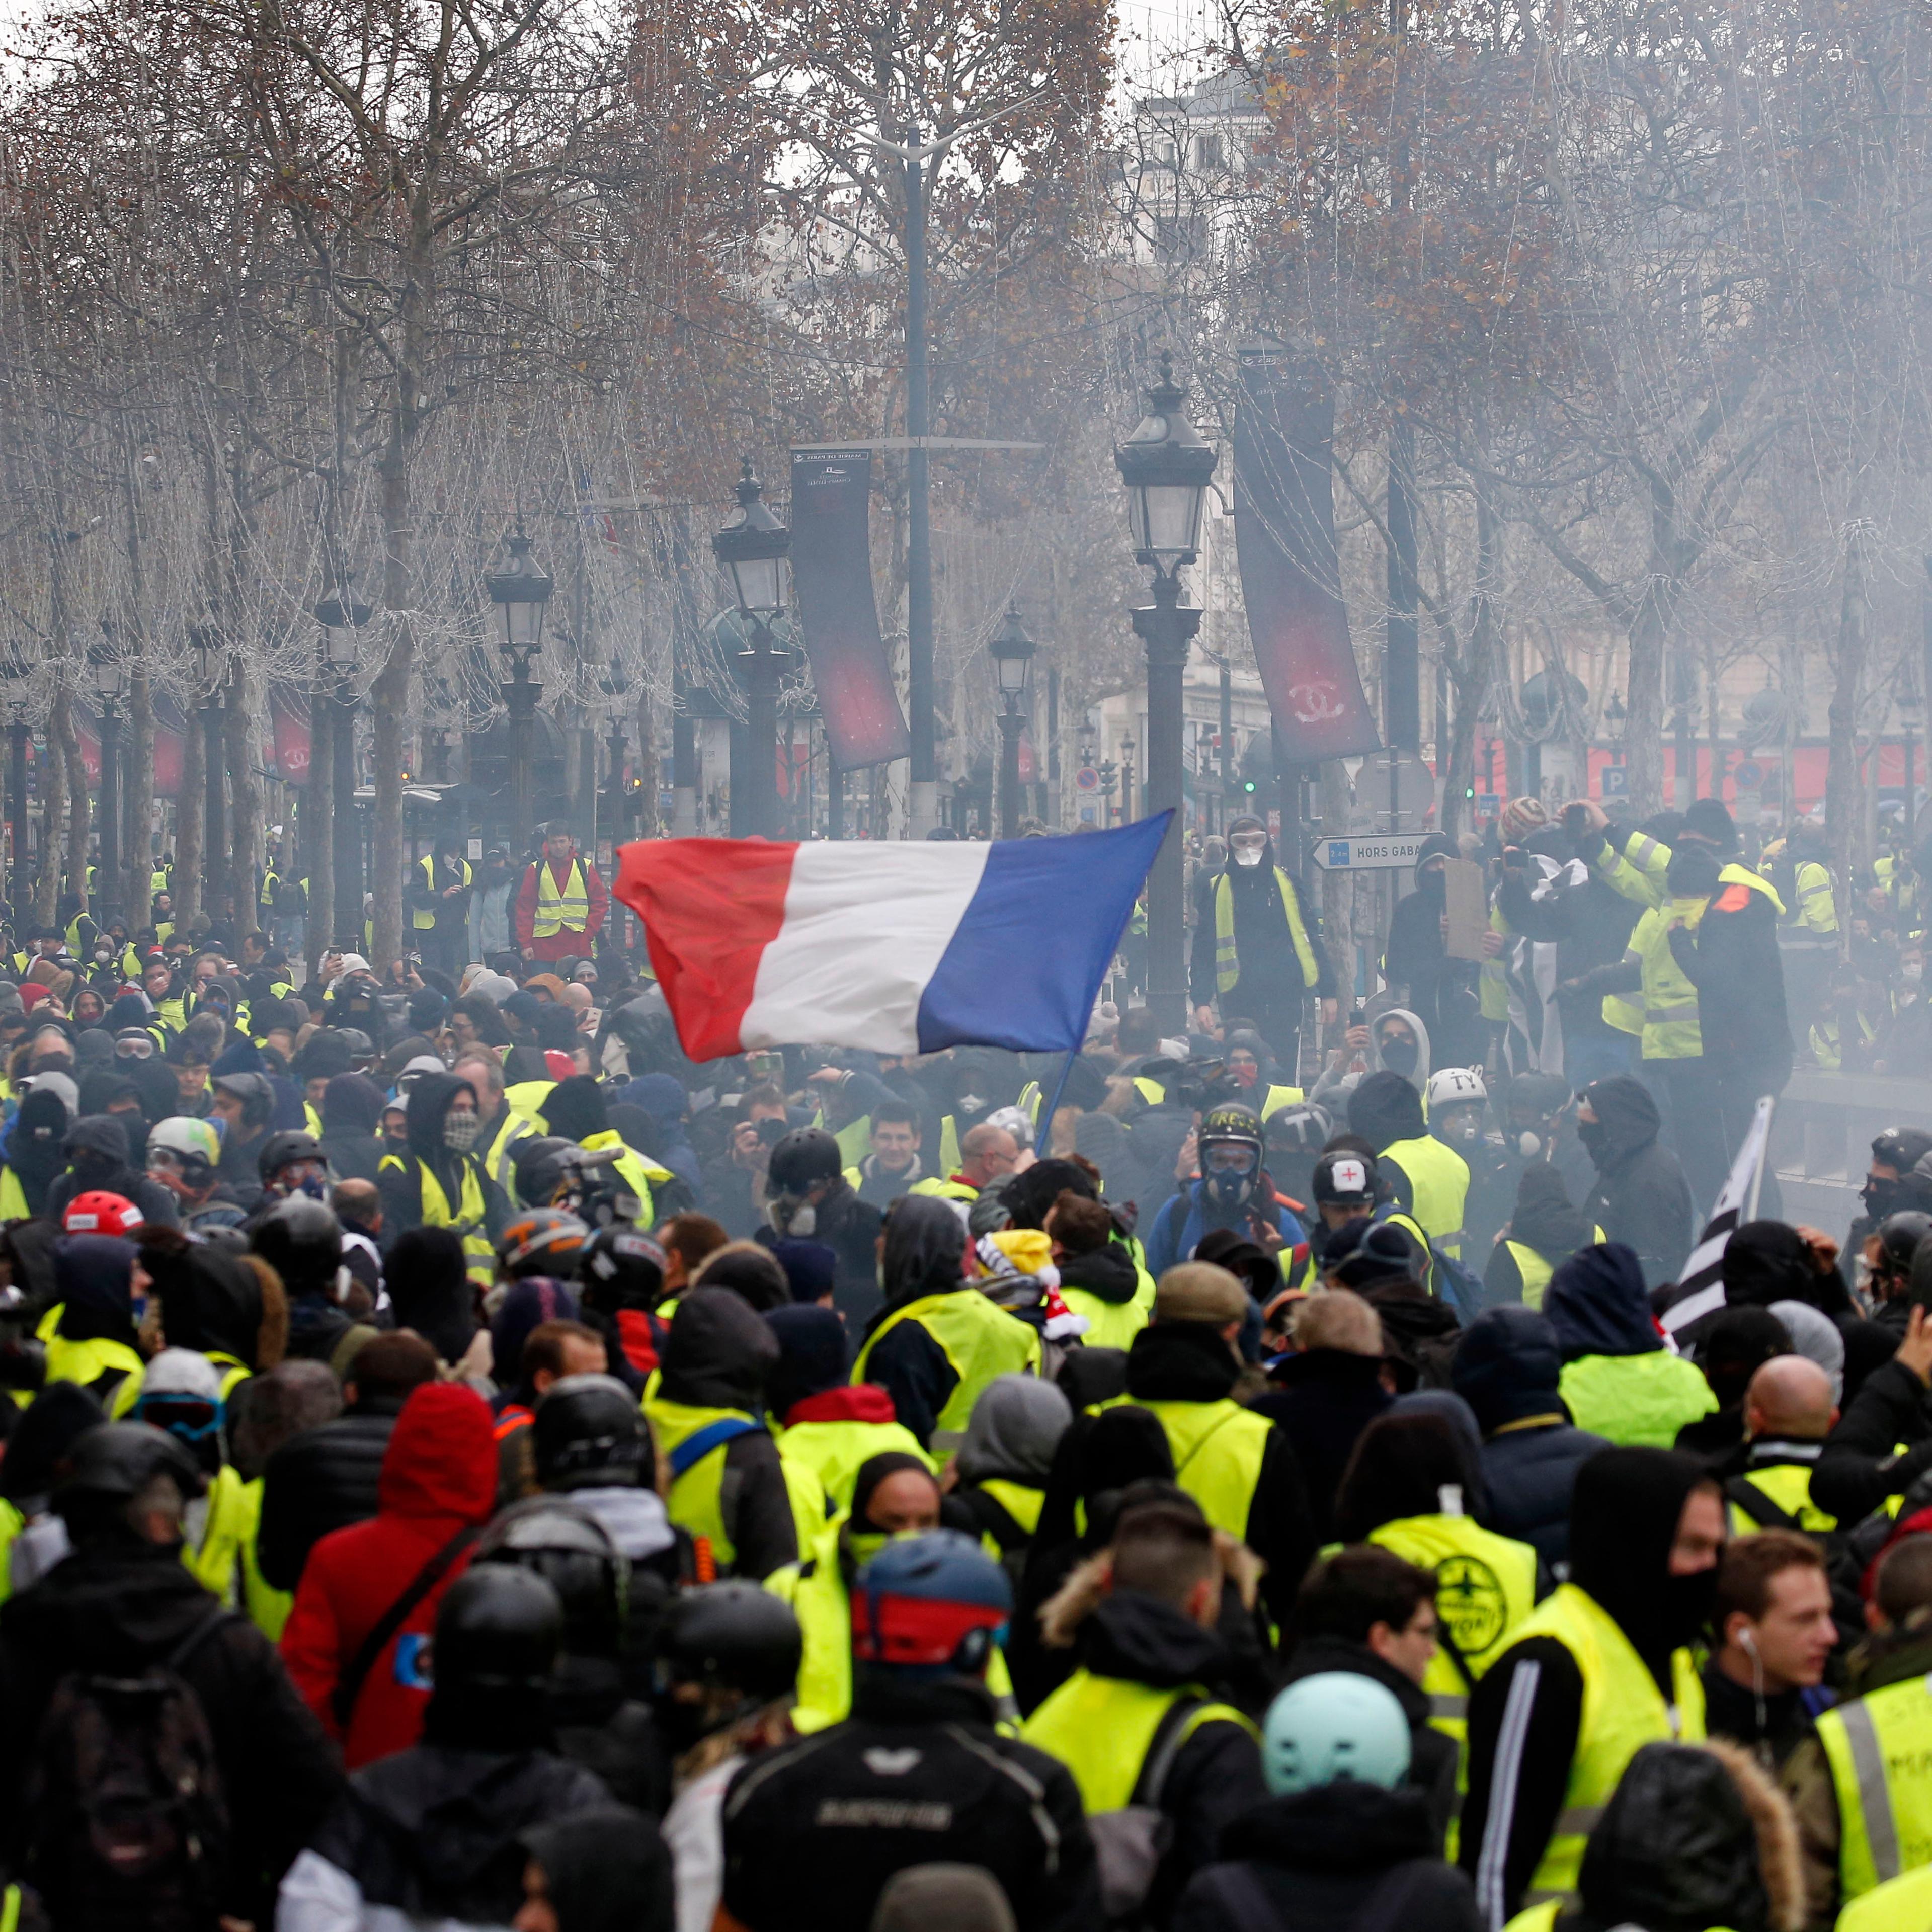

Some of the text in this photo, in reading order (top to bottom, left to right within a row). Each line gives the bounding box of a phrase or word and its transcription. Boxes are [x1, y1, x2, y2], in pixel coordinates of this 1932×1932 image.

[1610, 772, 1624, 791] P
[1358, 847, 1388, 858] HORS
[1392, 845, 1420, 856] GABA
